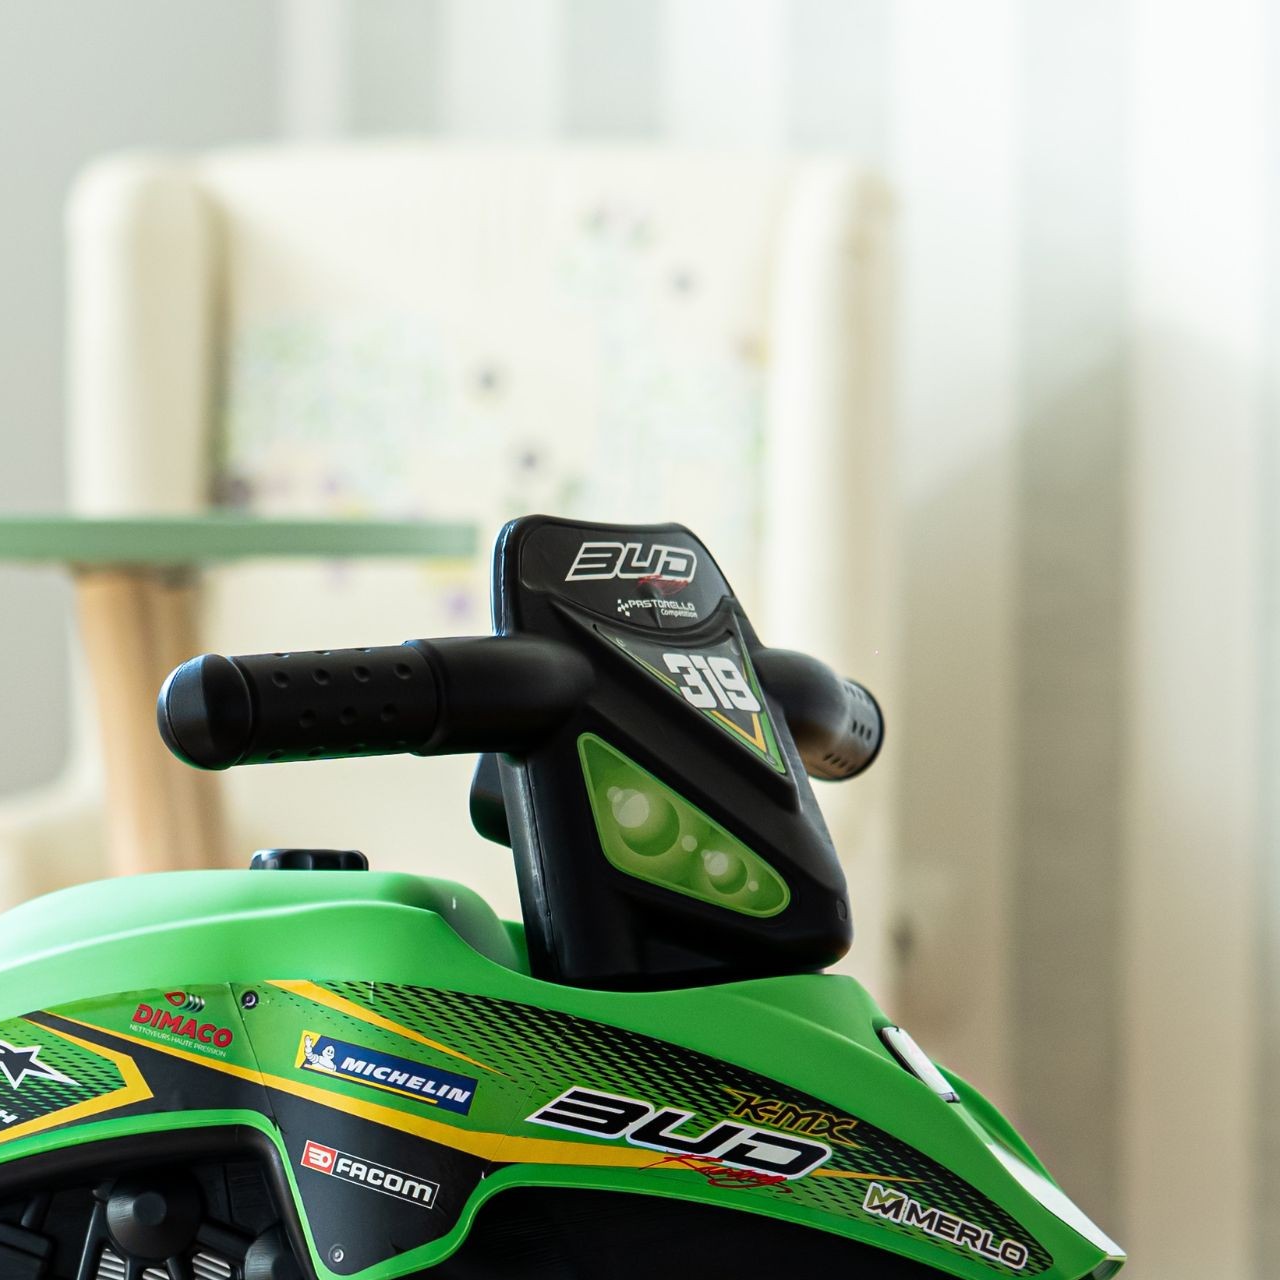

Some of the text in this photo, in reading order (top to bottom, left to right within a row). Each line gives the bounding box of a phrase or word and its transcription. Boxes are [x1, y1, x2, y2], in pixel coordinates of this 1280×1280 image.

[565, 541, 698, 584] BUD
[662, 652, 761, 712] 319
[132, 1003, 234, 1049] DIMACO
[170, 1035, 194, 1049] HAUTE
[193, 1041, 228, 1058] PRESSION
[340, 1056, 472, 1104] MICHELIN
[523, 1085, 833, 1182] BUD
[335, 1156, 434, 1203] FACOM
[903, 1199, 1029, 1271] MERLO
